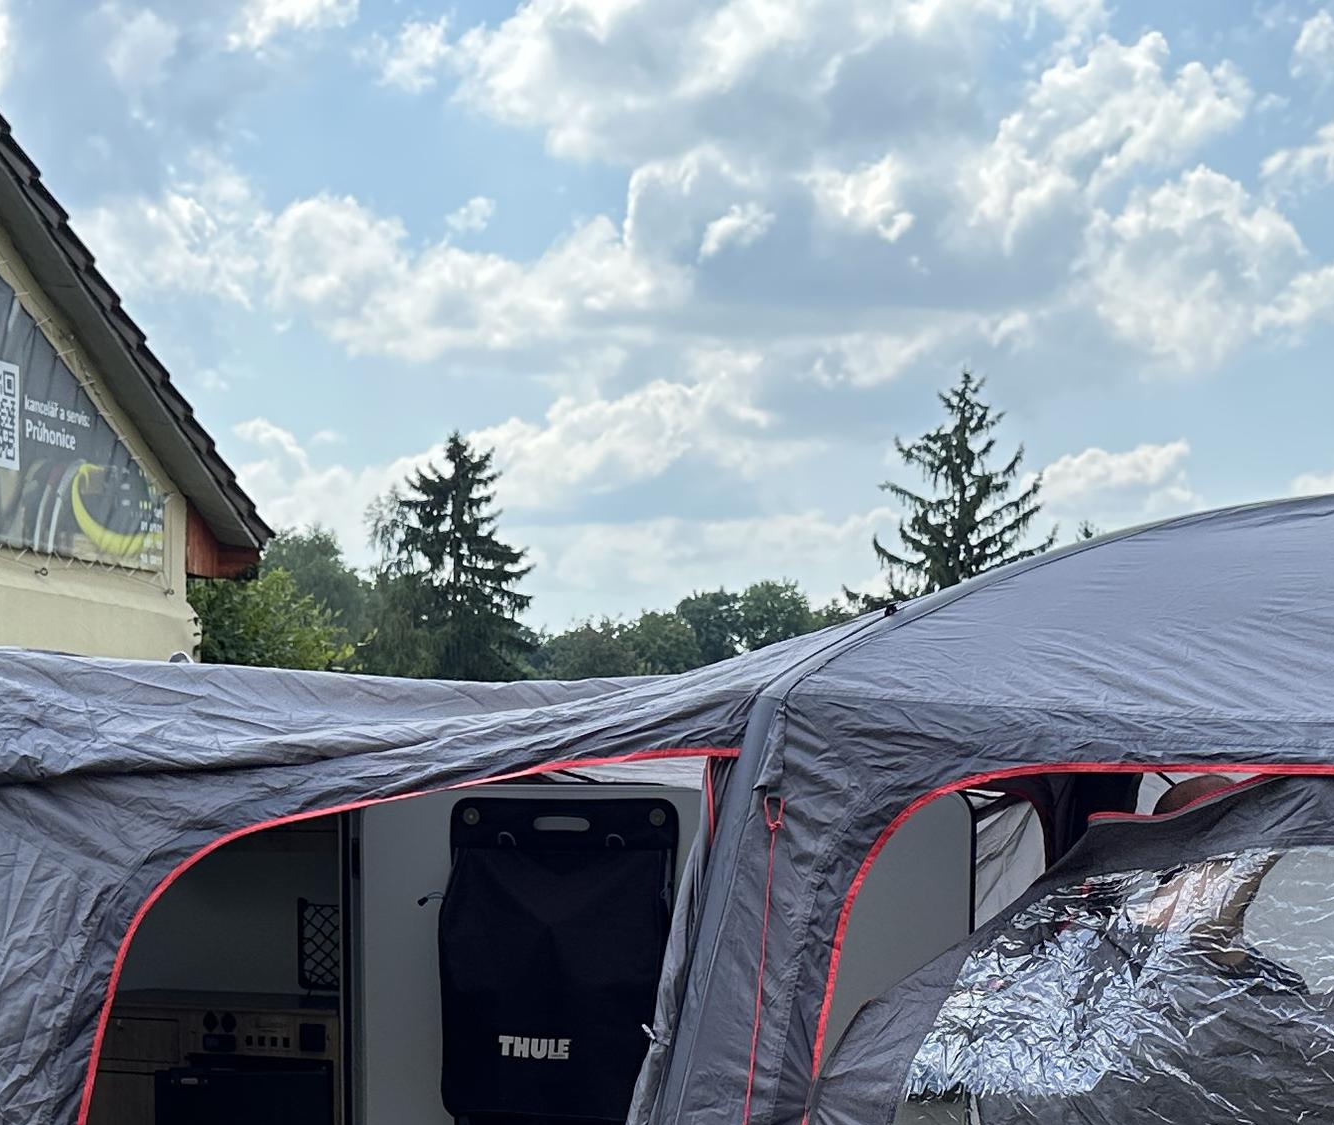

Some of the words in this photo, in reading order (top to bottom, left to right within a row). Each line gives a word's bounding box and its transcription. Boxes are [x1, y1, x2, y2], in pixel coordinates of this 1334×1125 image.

[59, 408, 65, 420] a
[25, 418, 76, 450] Průhonice
[498, 1035, 572, 1060] THULE
